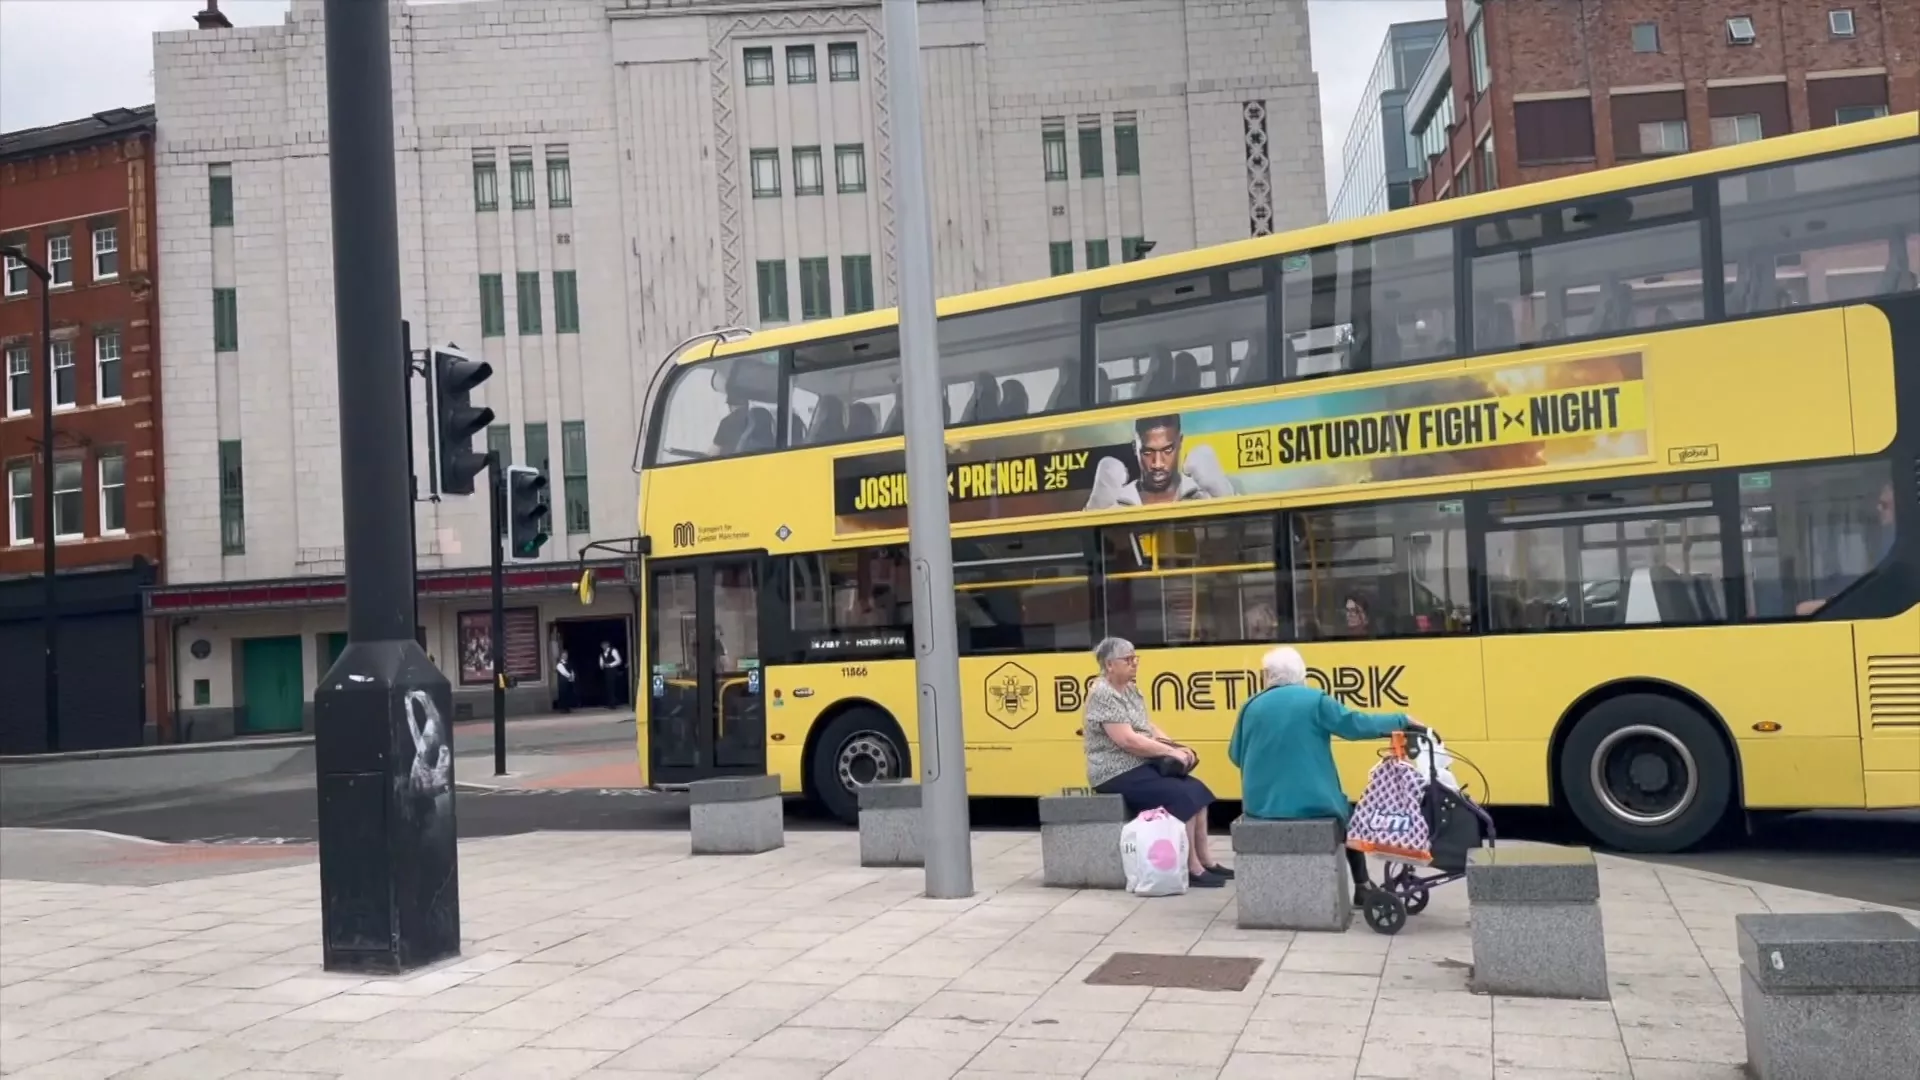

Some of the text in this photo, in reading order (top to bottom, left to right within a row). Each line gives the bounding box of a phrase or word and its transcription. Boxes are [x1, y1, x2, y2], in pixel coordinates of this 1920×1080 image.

[1278, 387, 1620, 465] SATURDAY FIGHT NIGHT
[958, 458, 1038, 499] PRENGA
[1043, 452, 1090, 472] JULY
[1044, 472, 1068, 491] 25
[1151, 665, 1409, 711] NETRK
